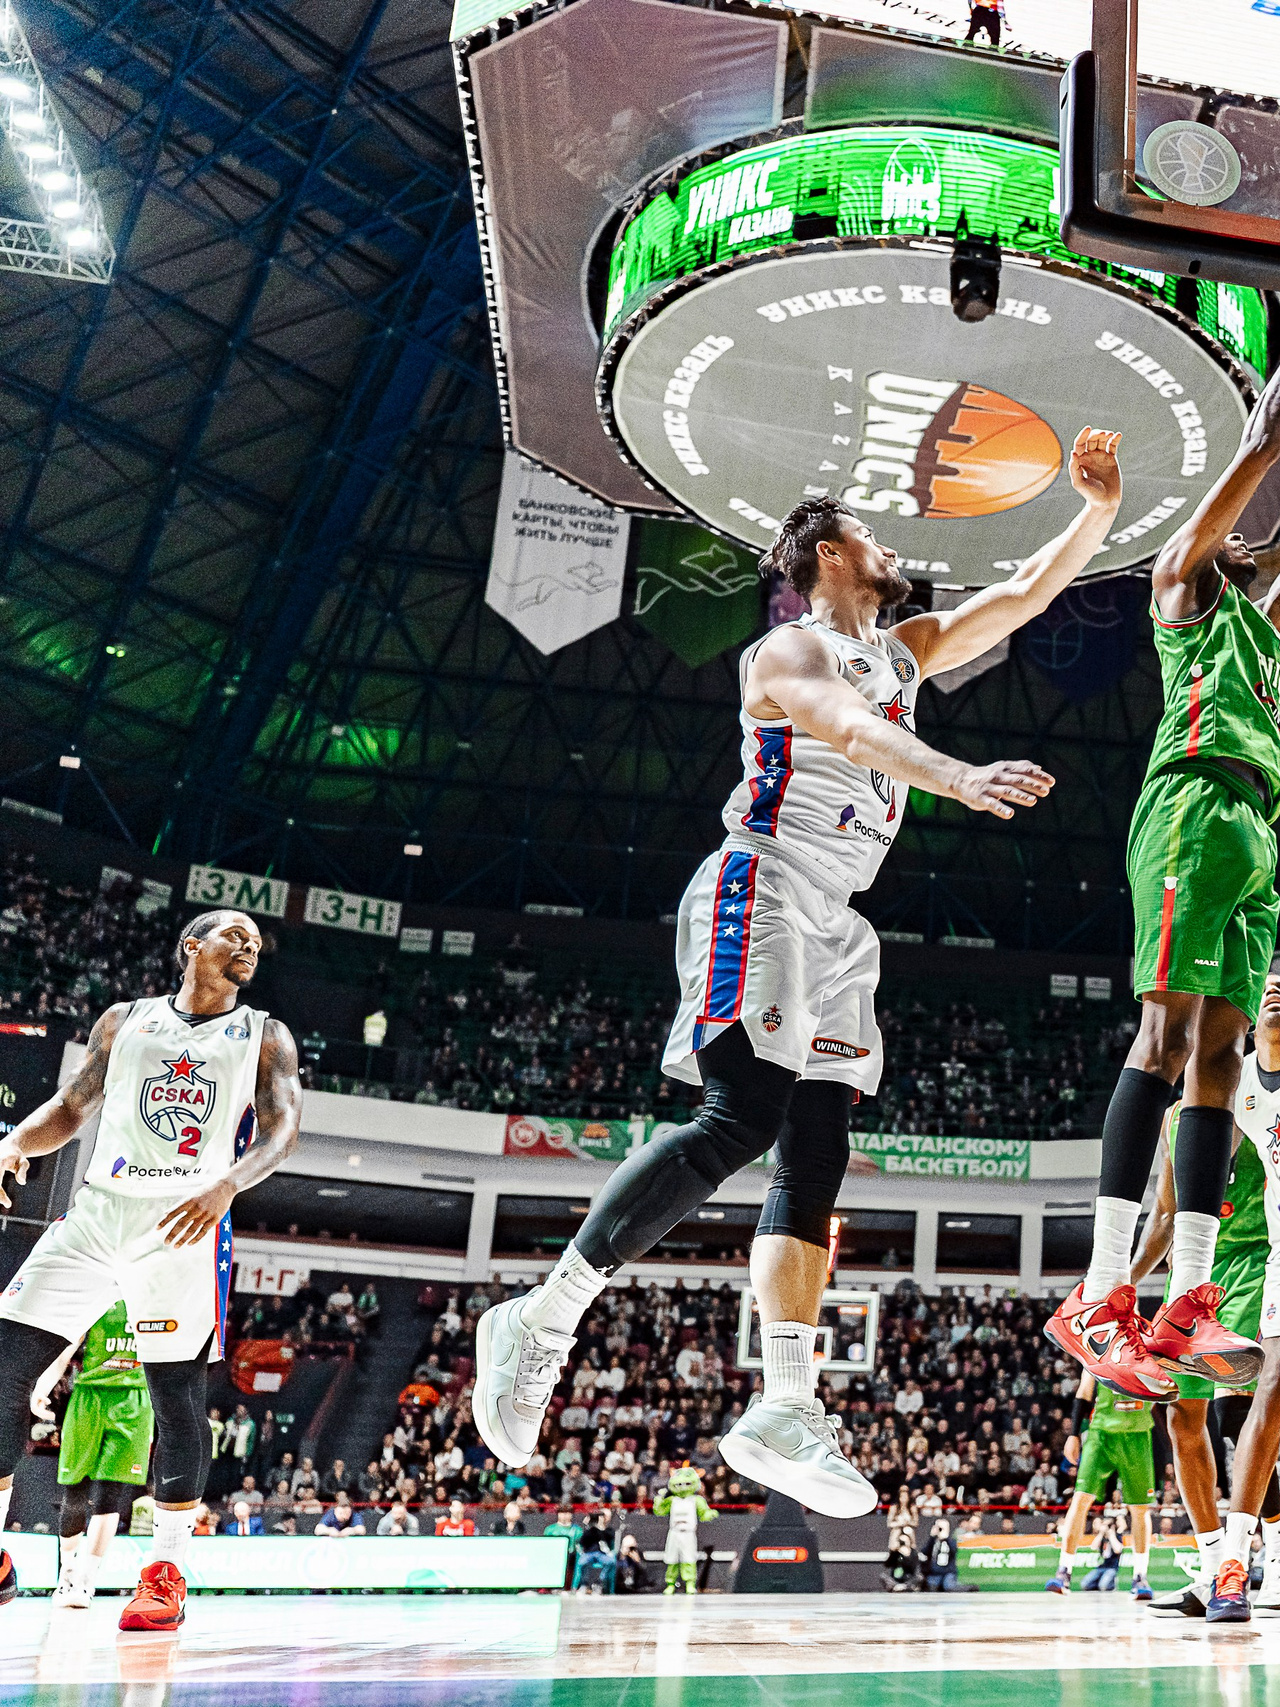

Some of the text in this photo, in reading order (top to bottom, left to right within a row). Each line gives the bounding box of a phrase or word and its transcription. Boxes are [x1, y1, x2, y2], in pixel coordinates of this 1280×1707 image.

[684, 157, 780, 235] УНИКС
[728, 205, 794, 246] КАЗАНЬ
[841, 370, 960, 517] UNICS
[763, 1014, 781, 1023] CSKA
[816, 1040, 857, 1058] WINLINE
[151, 1086, 206, 1106] CSKA
[177, 1126, 203, 1158] 2
[885, 1155, 1027, 1177] БАСКЕТБОЛУ
